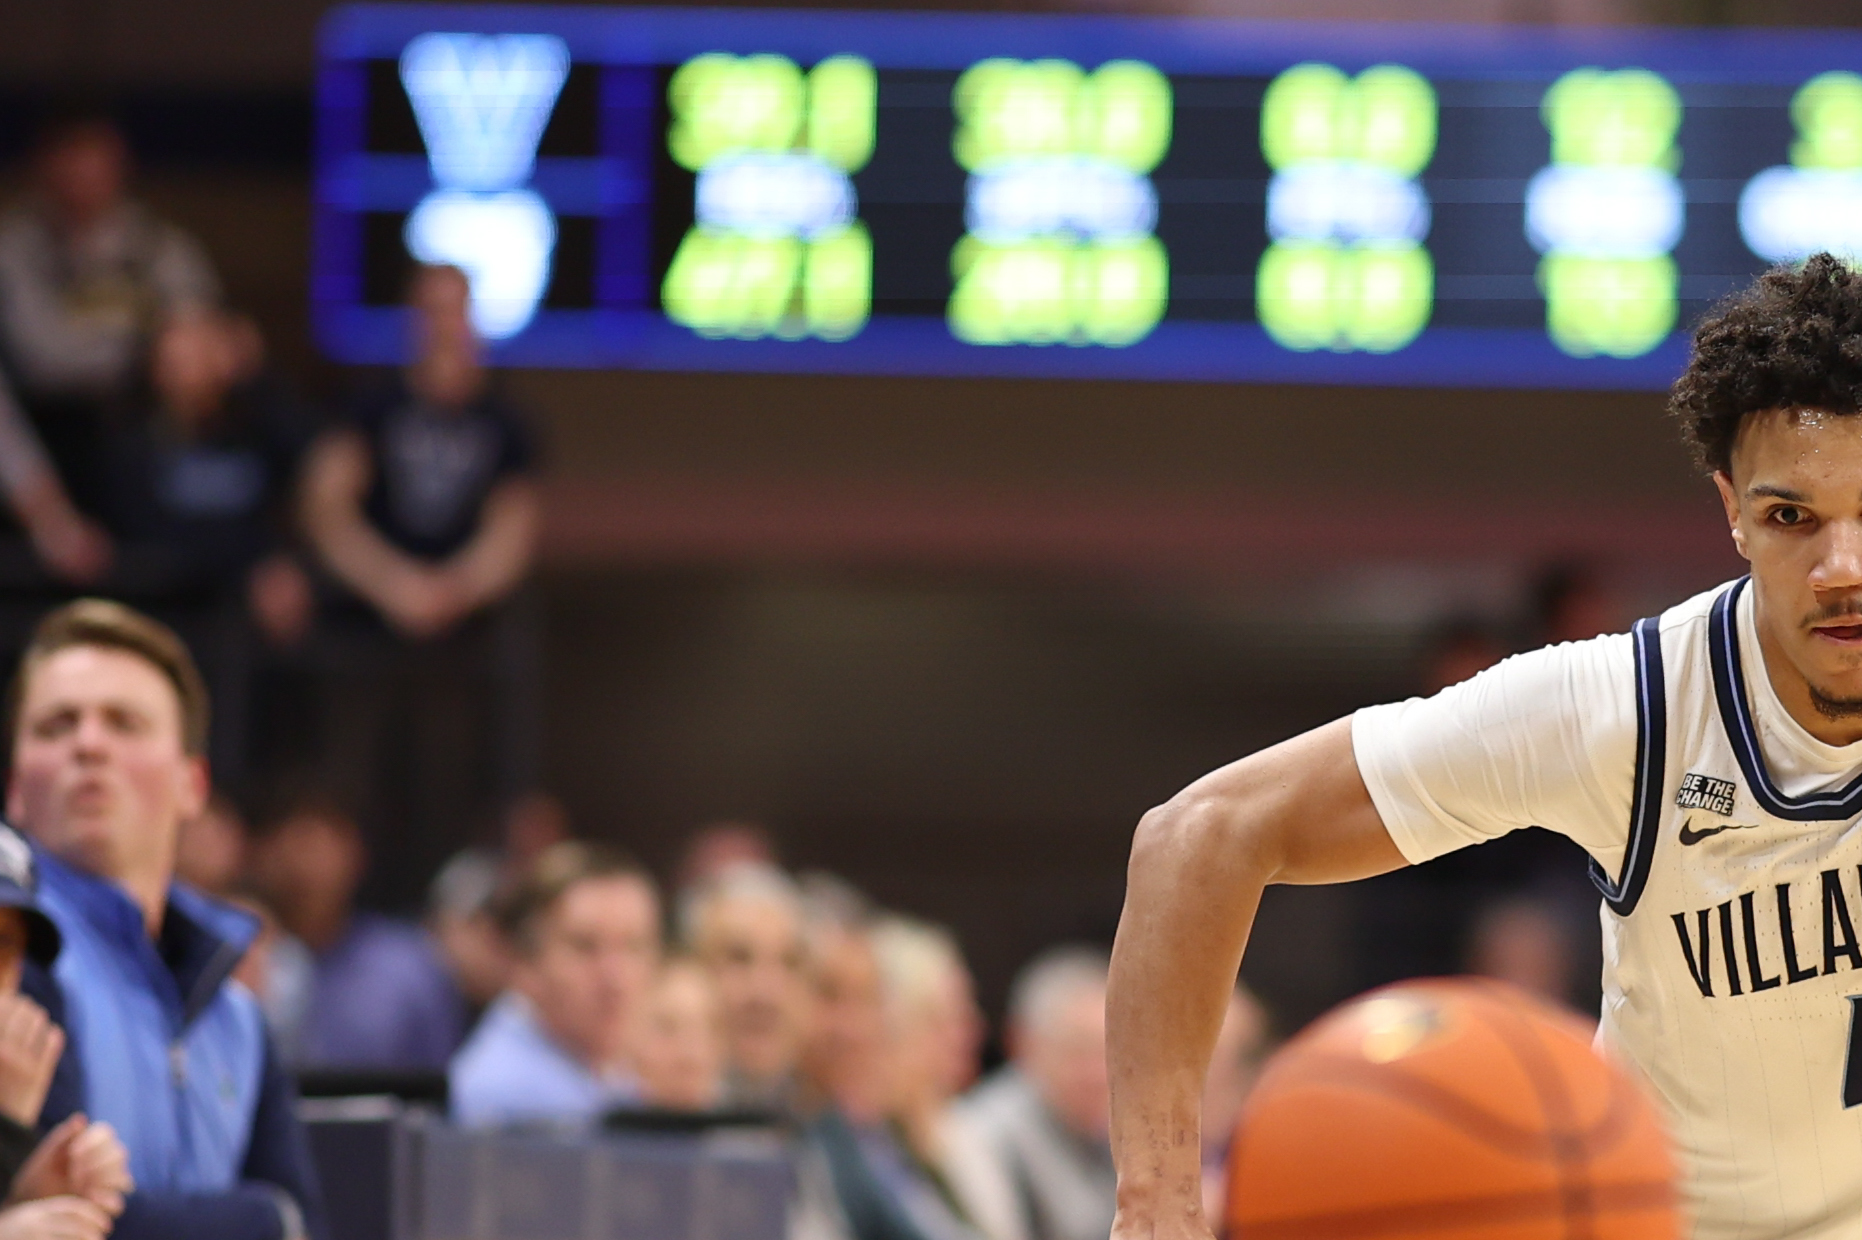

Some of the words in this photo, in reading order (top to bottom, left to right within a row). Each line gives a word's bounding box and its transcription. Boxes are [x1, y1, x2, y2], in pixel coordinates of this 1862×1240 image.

[1683, 775, 1703, 790] BE
[1705, 779, 1735, 798] THE
[1677, 789, 1733, 814] CHANGE
